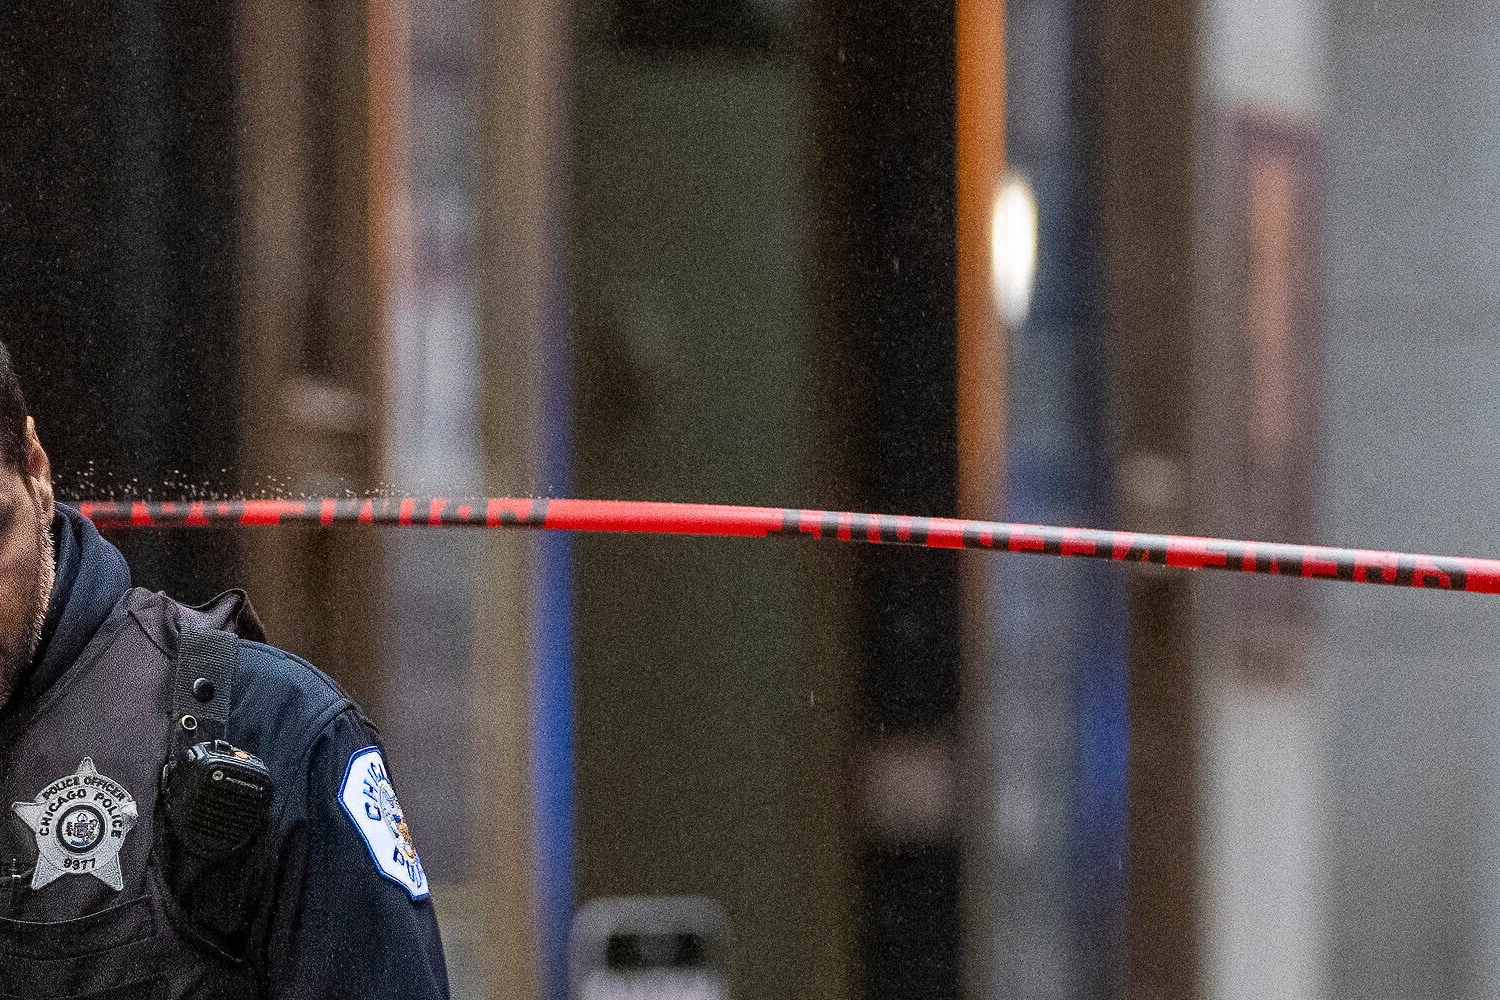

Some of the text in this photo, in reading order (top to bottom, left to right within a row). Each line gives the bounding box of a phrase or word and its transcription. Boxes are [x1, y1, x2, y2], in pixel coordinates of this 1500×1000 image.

[42, 776, 127, 801] POLICE OFFICER
[40, 788, 123, 838] CHICAGO POLICE
